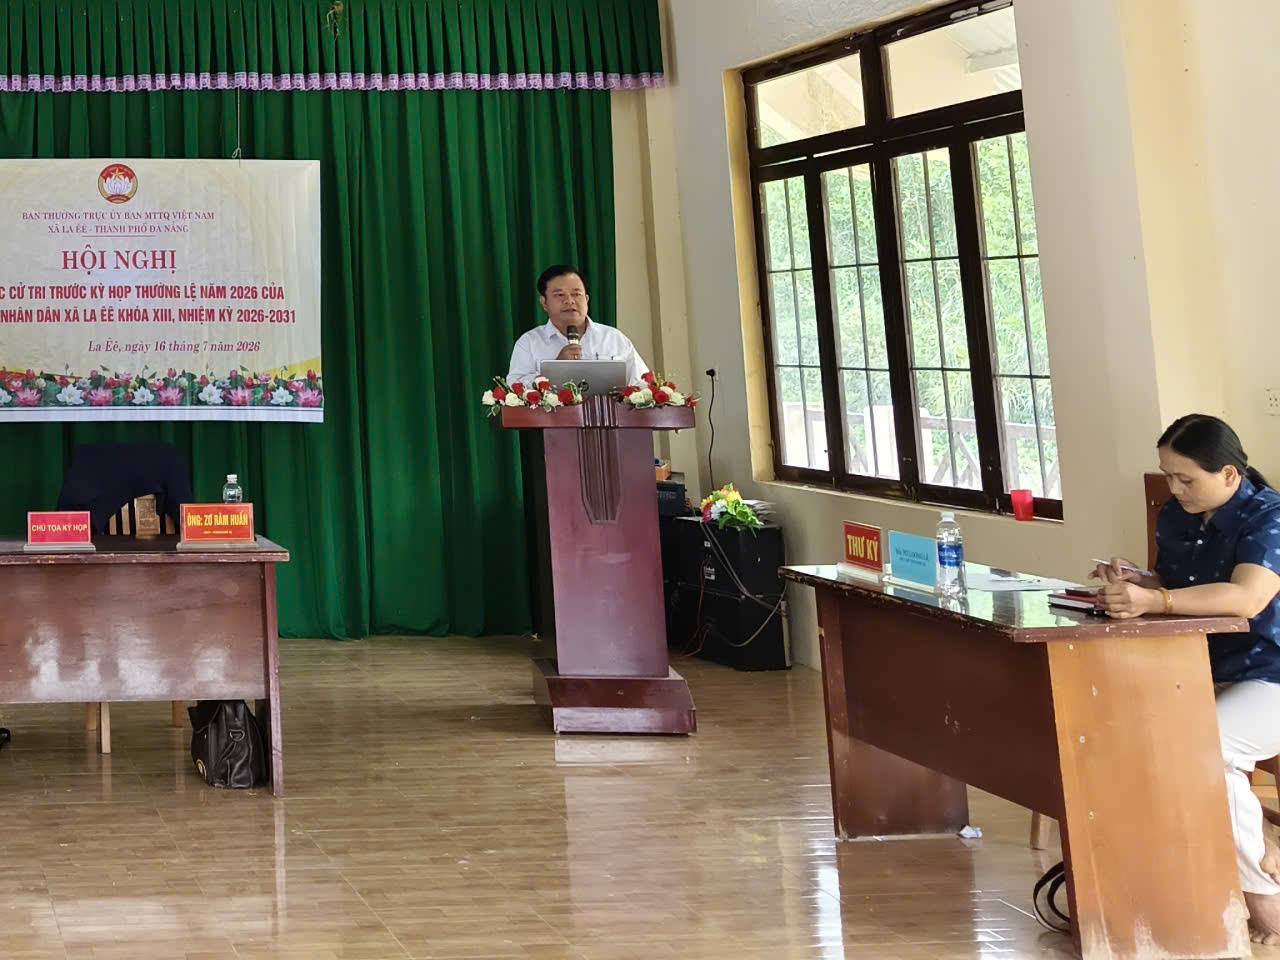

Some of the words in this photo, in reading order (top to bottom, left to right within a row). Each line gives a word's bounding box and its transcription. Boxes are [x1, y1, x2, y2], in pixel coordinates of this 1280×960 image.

[22, 211, 40, 220] BAN
[124, 211, 142, 220] BAN
[144, 211, 170, 221] MTTQ
[194, 211, 215, 220] NAM
[62, 244, 107, 275] HỘI
[114, 249, 177, 275] NGHỊ
[9, 282, 27, 300] CỬ
[28, 286, 46, 300] TRI
[49, 283, 87, 300] TRƯỚC
[108, 285, 132, 302] HỌP
[135, 282, 181, 299] THƯỜNG
[184, 283, 196, 302] LỆ
[200, 283, 227, 299] NĂM
[230, 285, 258, 300] 2026
[261, 282, 285, 300] CỦA
[0, 306, 33, 323] NHÂN
[36, 306, 61, 323] DÂN
[64, 306, 80, 322] XÃ
[83, 309, 97, 323] LA
[117, 306, 149, 322] KHÓA
[152, 308, 175, 325] XIII,
[178, 306, 215, 325] NHIỆM
[236, 309, 296, 323] 2026-2031
[88, 341, 102, 352] La
[124, 342, 151, 354] ngày
[154, 341, 166, 352] 16
[168, 341, 200, 354] tháng
[203, 341, 209, 352] 7
[210, 342, 233, 352] năm
[236, 341, 261, 352] 2026
[847, 534, 865, 558] THƯ
